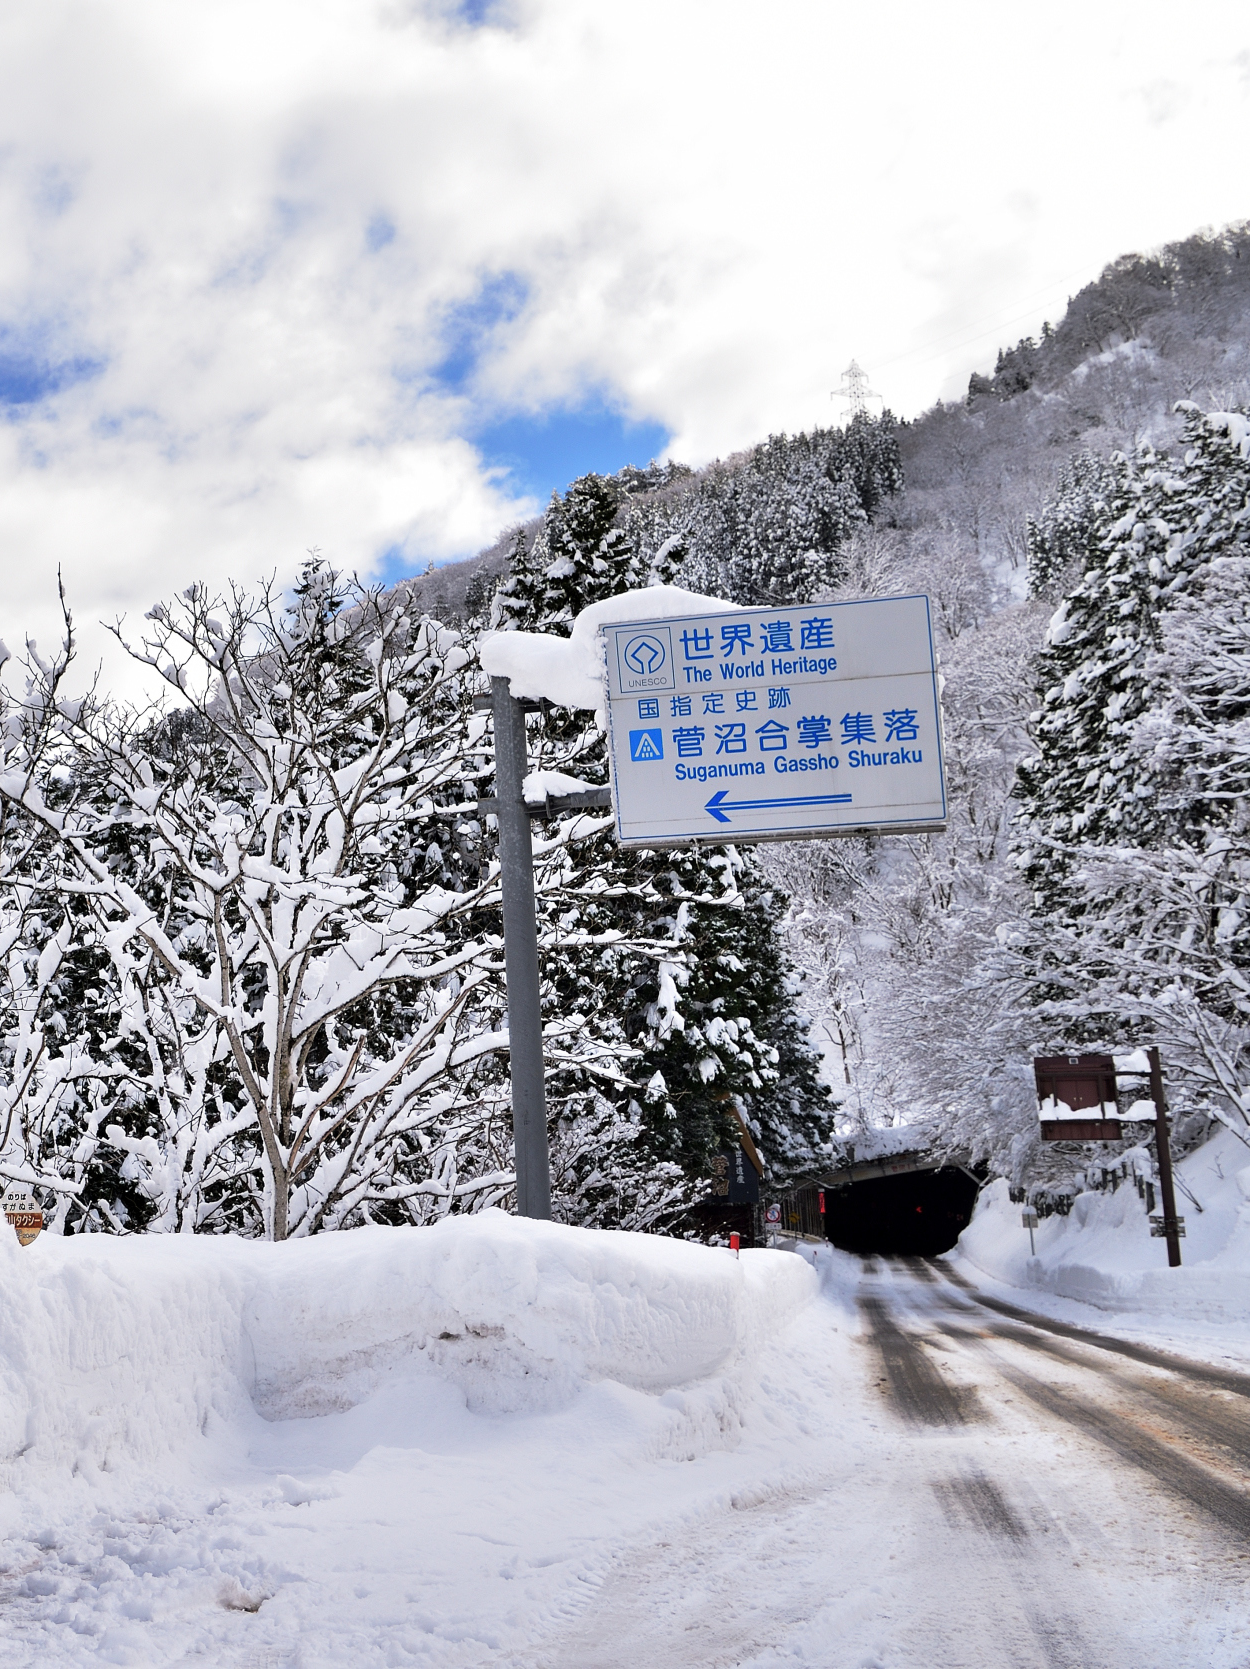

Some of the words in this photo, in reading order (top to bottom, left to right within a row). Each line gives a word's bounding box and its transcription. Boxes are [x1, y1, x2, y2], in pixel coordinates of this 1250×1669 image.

[679, 616, 836, 661] 世界遺産
[628, 676, 668, 688] UNESCO
[683, 665, 713, 684] The
[720, 660, 766, 680] World
[771, 656, 838, 676] Heritage
[638, 687, 792, 720] 国指定史跡
[672, 708, 921, 759] 菅沼合掌集落
[674, 754, 766, 783] Suganuma
[773, 754, 840, 774] Gassho
[848, 747, 923, 769] Shuraku
[2, 1203, 34, 1211] すがぬま
